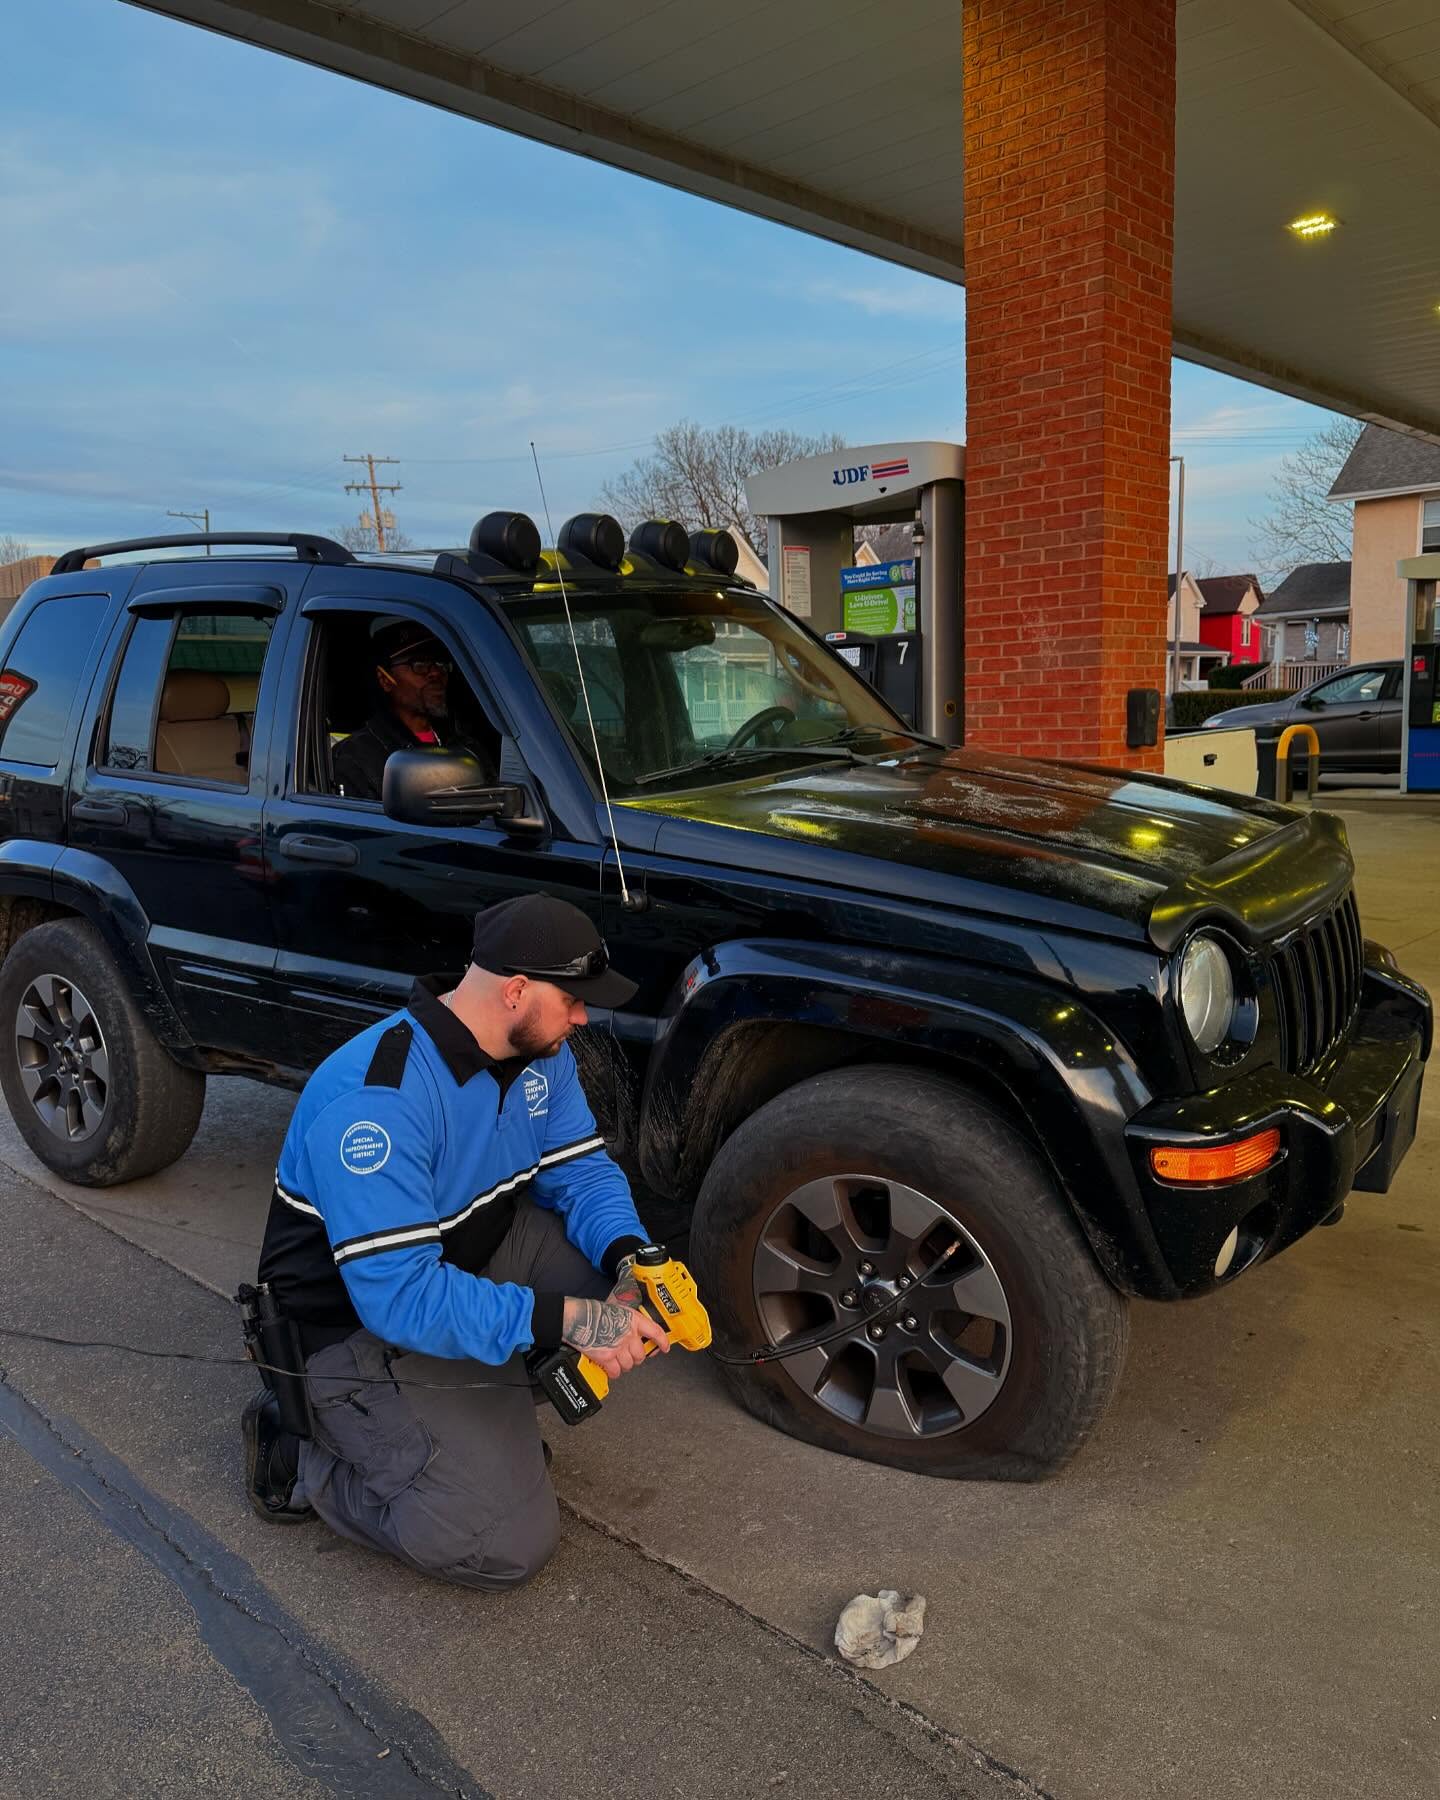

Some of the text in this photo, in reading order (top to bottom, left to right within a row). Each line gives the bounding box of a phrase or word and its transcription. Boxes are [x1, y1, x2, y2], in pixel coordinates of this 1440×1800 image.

[833, 465, 869, 485] UDF
[897, 641, 909, 665] 7
[352, 1136, 373, 1145] SPECIAL
[345, 1142, 384, 1152] IMPROVEMENT
[352, 1150, 375, 1159] DISTRICT
[577, 1396, 588, 1408] 12V
